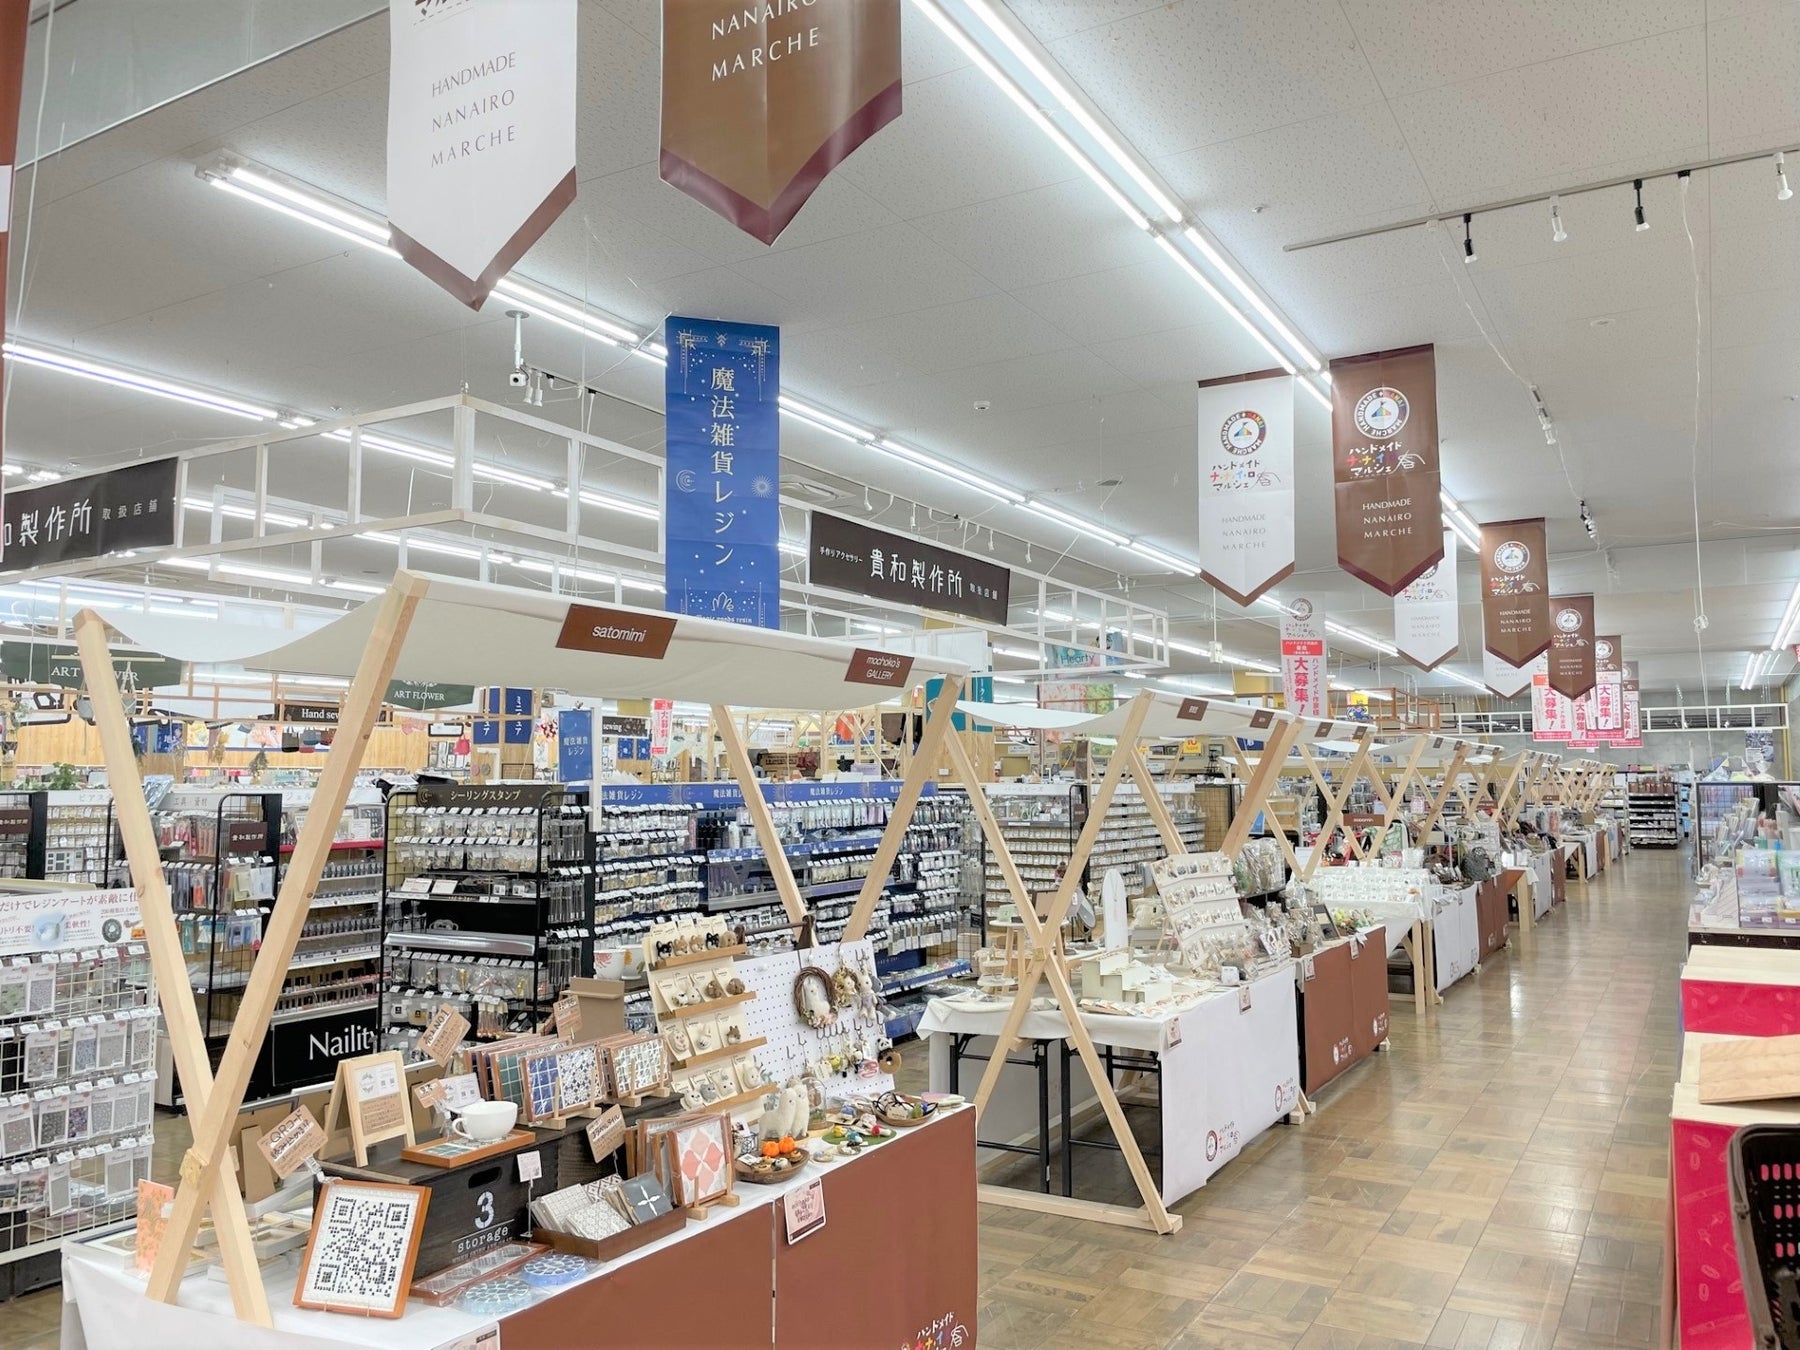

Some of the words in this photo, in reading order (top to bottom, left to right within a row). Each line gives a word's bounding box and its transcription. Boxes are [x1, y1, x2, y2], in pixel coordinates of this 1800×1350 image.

[711, 27, 820, 82] MARCHE
[431, 52, 517, 98] HANDMADE
[431, 89, 515, 133] NANAIRO
[431, 125, 516, 168] MARCHE
[1349, 440, 1403, 455] ハンドメイド
[711, 366, 736, 567] 魔法雑貨レジン
[1350, 463, 1392, 476] マルシェ
[1212, 479, 1250, 492] マルシェ
[102, 498, 158, 521] 取扱店舗
[1362, 497, 1412, 510] HANDMADE
[1221, 513, 1267, 525] HANDMADE
[1363, 512, 1412, 525] NANAIRO
[1222, 527, 1267, 538] NANAIRO
[1363, 526, 1413, 539] MARCHE
[1222, 541, 1266, 551] MARCHE
[869, 548, 963, 599] 貴和製作所
[1499, 608, 1531, 616] HANDMADE
[592, 624, 648, 642] satomimi
[1060, 652, 1096, 665] Hearty
[50, 666, 81, 678] ART
[866, 669, 895, 681] GALLERY
[393, 690, 412, 699] ART
[412, 691, 446, 702] FLOWER
[301, 708, 325, 719] Hand
[602, 723, 623, 734] sewing
[568, 746, 585, 756] レジン
[450, 789, 522, 801] シーリングスタンプ
[809, 785, 845, 797] 魔法雑貨レジン
[308, 1024, 376, 1061] Nailit
[474, 1190, 495, 1229] 3
[457, 1225, 509, 1254] storage
[916, 1311, 955, 1340] ハンドメイド
